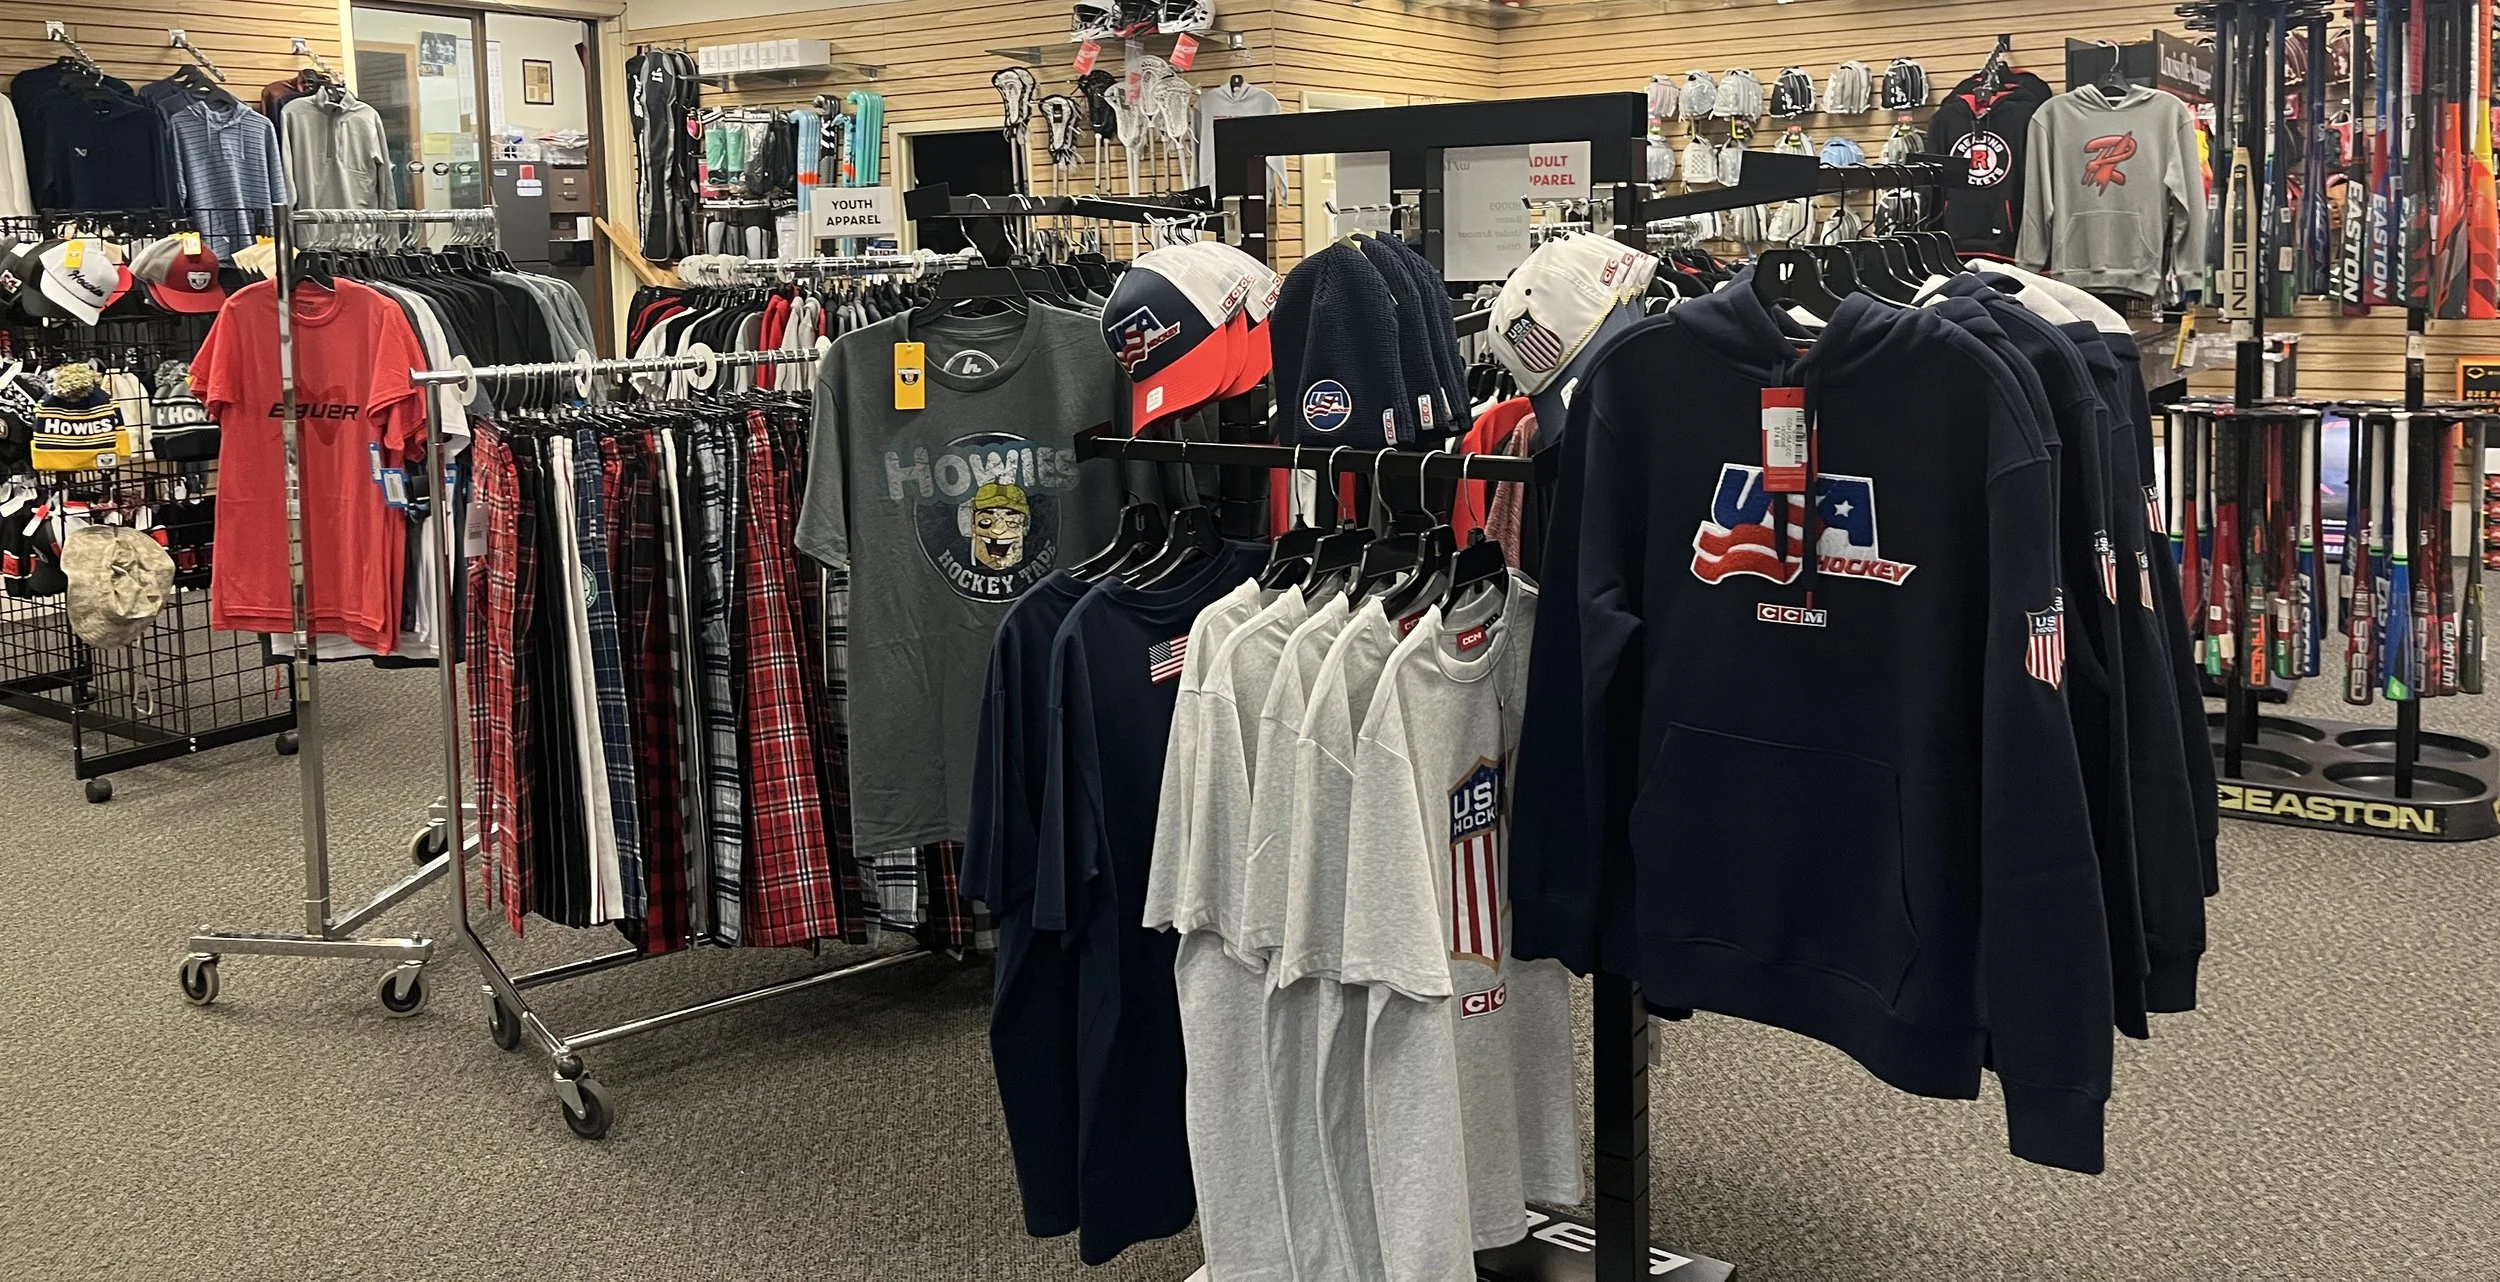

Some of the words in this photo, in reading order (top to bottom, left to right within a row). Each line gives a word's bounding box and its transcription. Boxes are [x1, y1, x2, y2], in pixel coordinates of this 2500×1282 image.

[1970, 150, 1989, 170] R
[1530, 174, 1575, 186] PAREL
[1967, 167, 2005, 186] CKETS
[831, 199, 873, 210] YOUTH
[826, 214, 881, 226] APPAREL
[2342, 180, 2364, 303] EASTON
[2373, 193, 2388, 299] EASTON
[2232, 243, 2247, 312] ICON
[1506, 317, 1532, 339] USA
[45, 417, 112, 436] HOWIES
[884, 446, 1081, 501] HOWIES
[937, 549, 1014, 594] HOCKEY
[1817, 555, 1911, 583] HOCKEY
[1404, 617, 1420, 631] CC
[1760, 605, 1825, 625] CCM
[2036, 615, 2056, 628] US
[1462, 631, 1482, 646] CCM
[2351, 620, 2369, 701] SPEED
[2414, 616, 2429, 693] SPEED
[2442, 621, 2457, 687] QUANTUM
[1454, 810, 1497, 835] HOCK
[2244, 788, 2435, 834] EASTON
[1464, 985, 1506, 1014] CC
